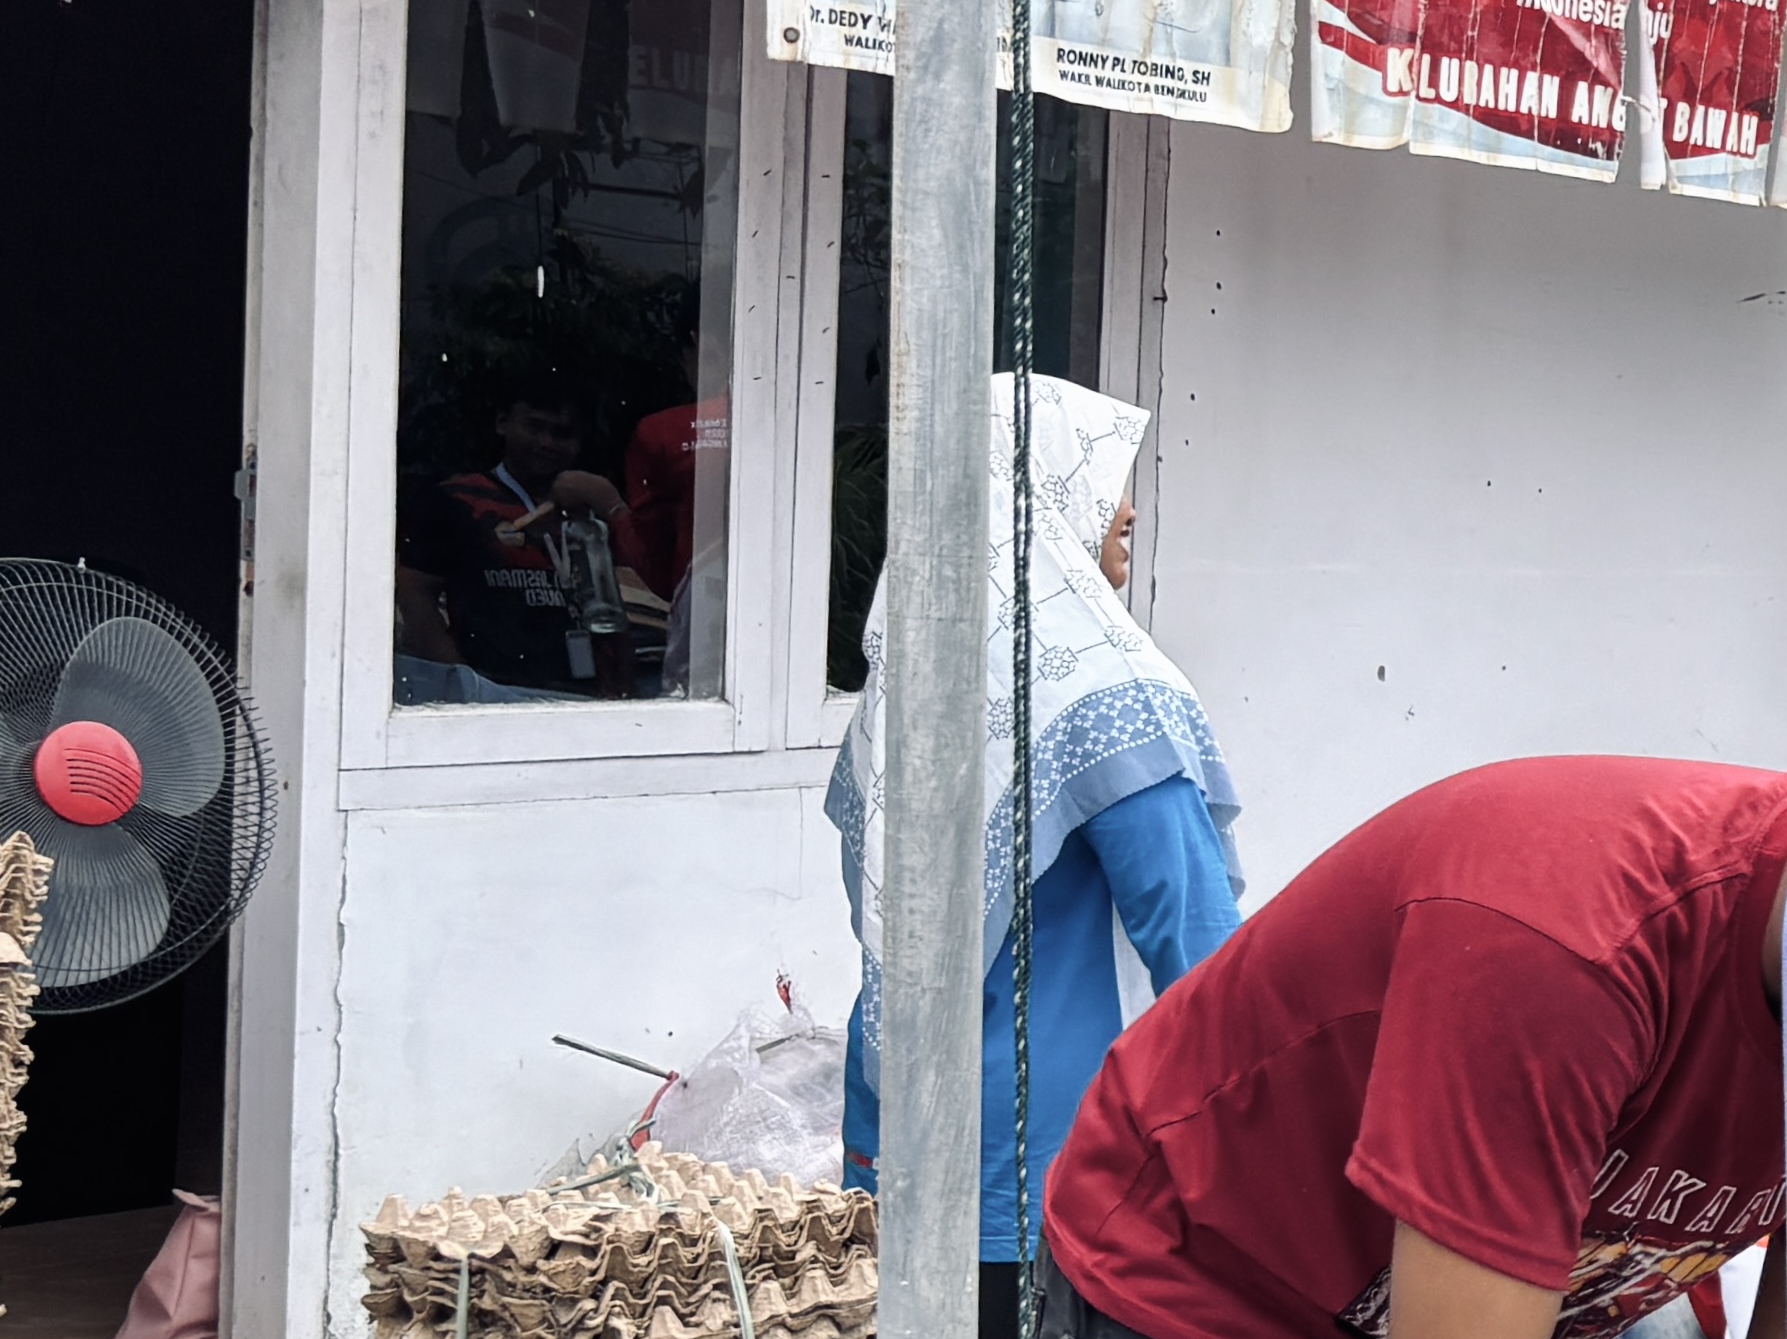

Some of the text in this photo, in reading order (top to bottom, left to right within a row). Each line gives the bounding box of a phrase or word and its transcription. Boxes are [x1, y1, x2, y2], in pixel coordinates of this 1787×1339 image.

[828, 9, 873, 30] DEDY
[843, 33, 896, 52] WALIKO
[1056, 47, 1109, 71] RONNY
[1191, 70, 1211, 87] SH
[1386, 48, 1560, 119] KLURAHAN
[1672, 101, 1760, 155] BAWAH
